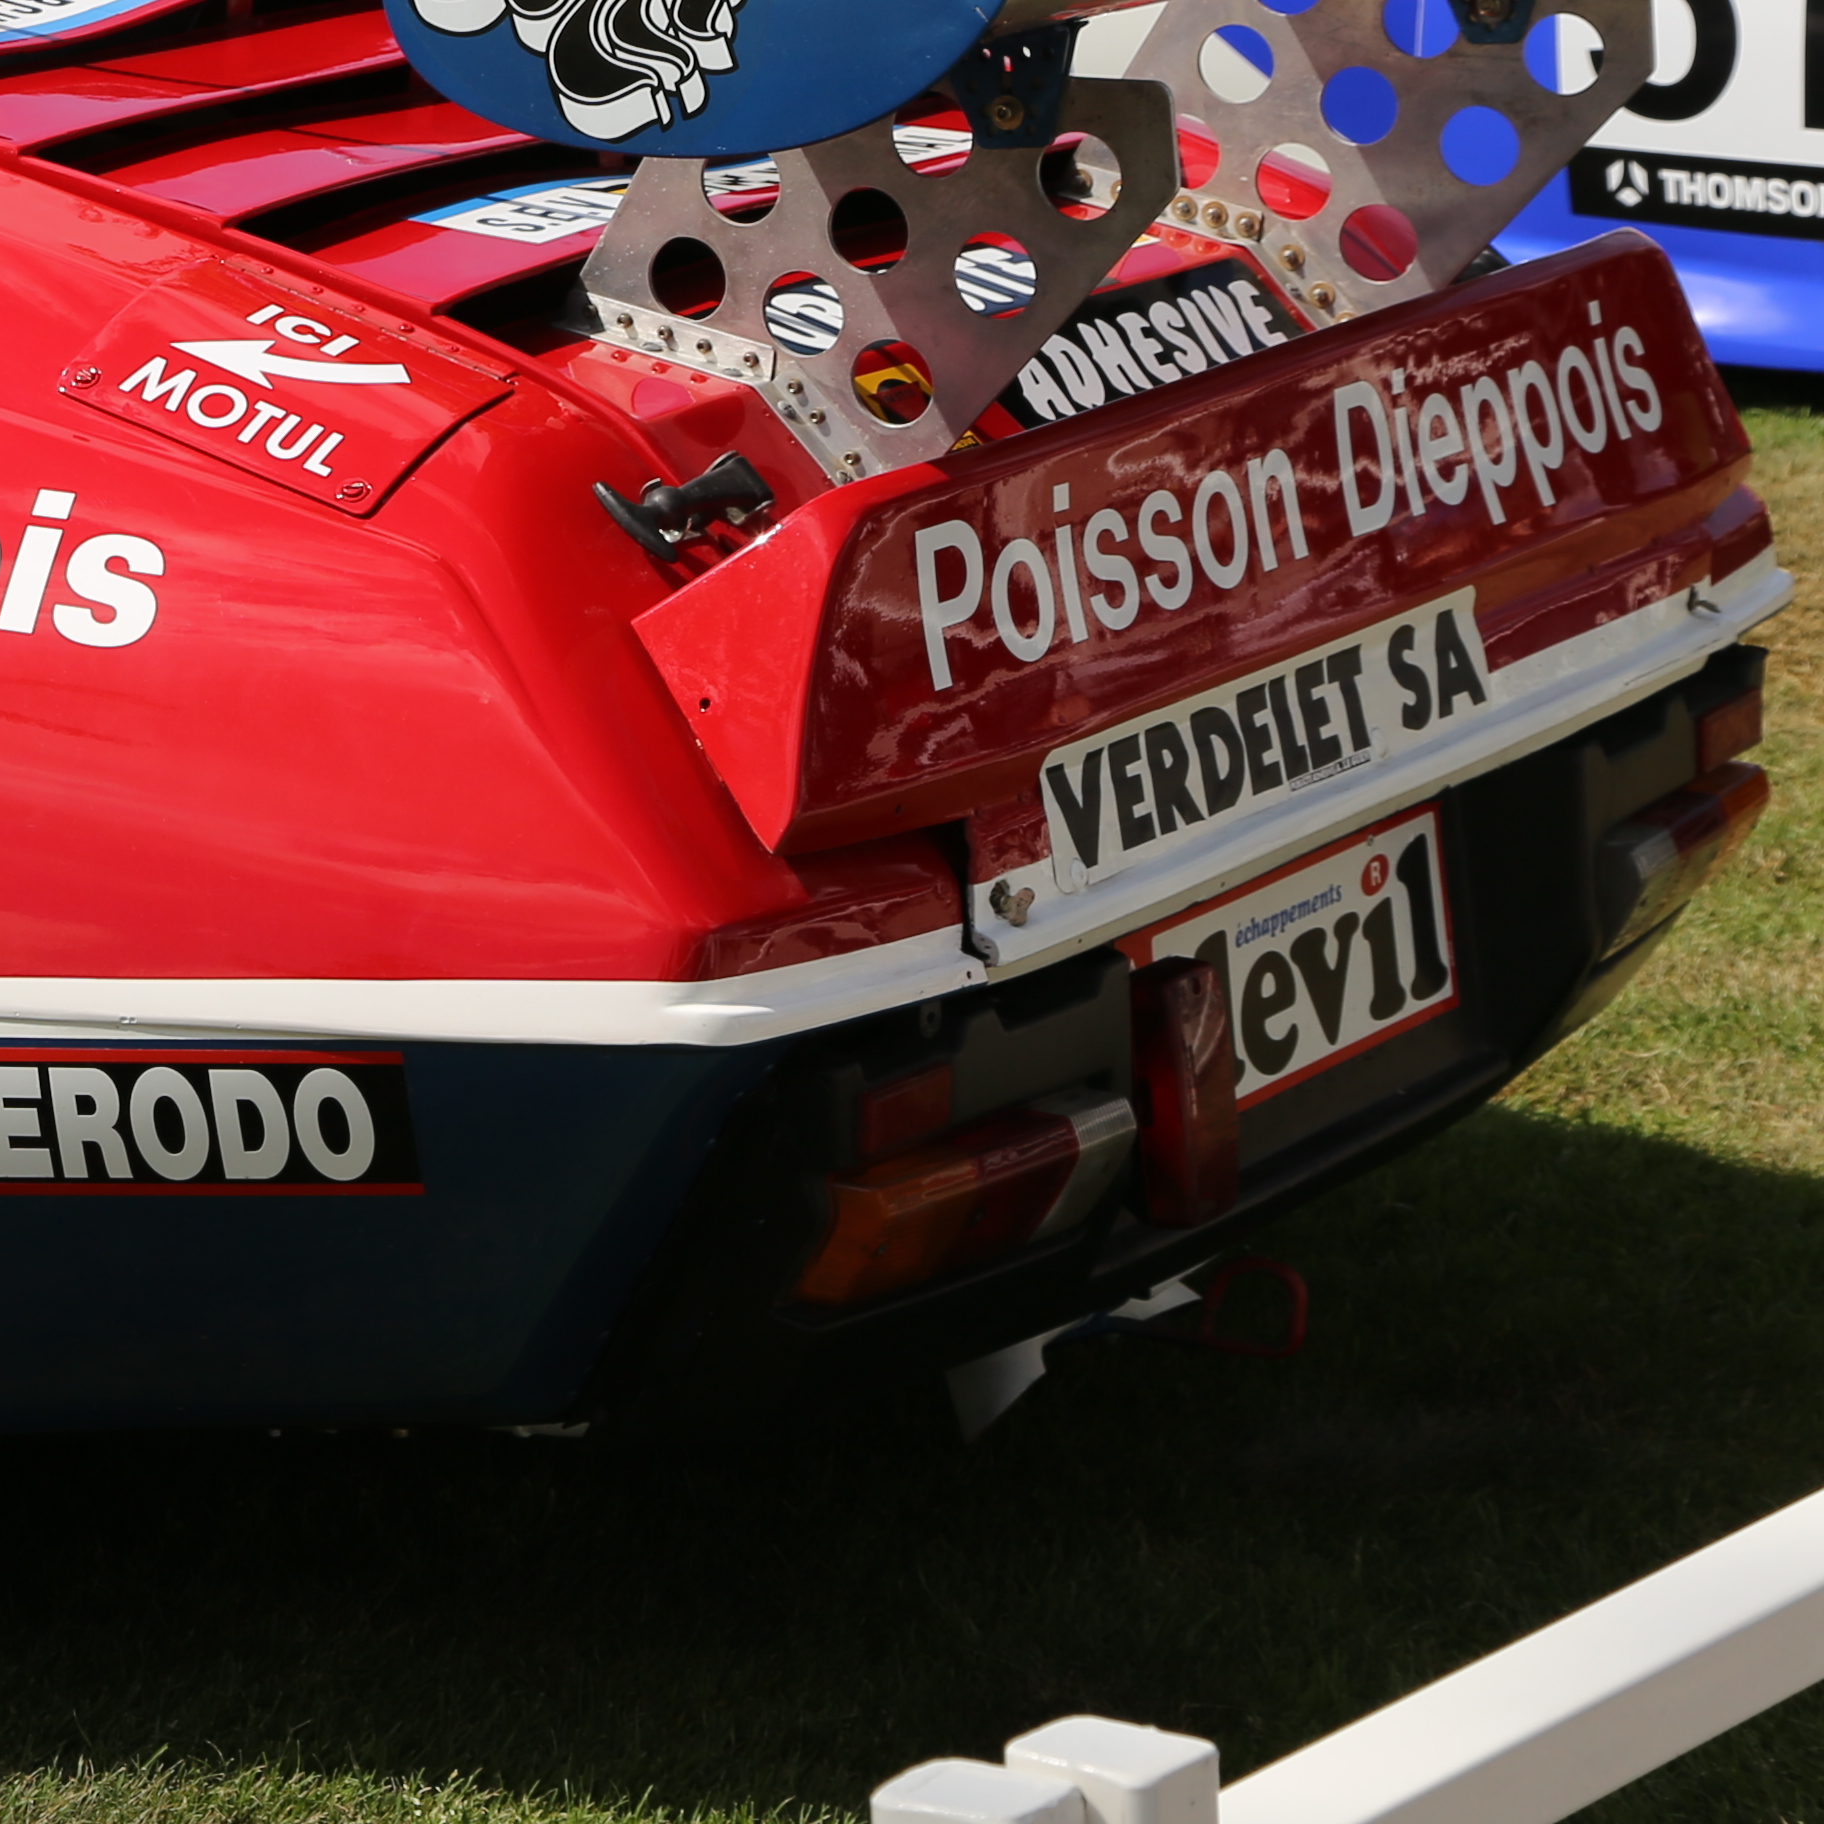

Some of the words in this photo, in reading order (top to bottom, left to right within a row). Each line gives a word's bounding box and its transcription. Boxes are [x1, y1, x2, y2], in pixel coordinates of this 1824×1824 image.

[244, 303, 361, 358] ICI
[1016, 279, 1289, 421] ADHESIVE
[117, 356, 347, 479] MOTUL
[914, 446, 1310, 691] Poisson
[1333, 300, 1663, 539] Dieppois
[1046, 643, 1378, 870] VERDELET
[1386, 607, 1490, 733] SA
[1234, 882, 1344, 949] échappements
